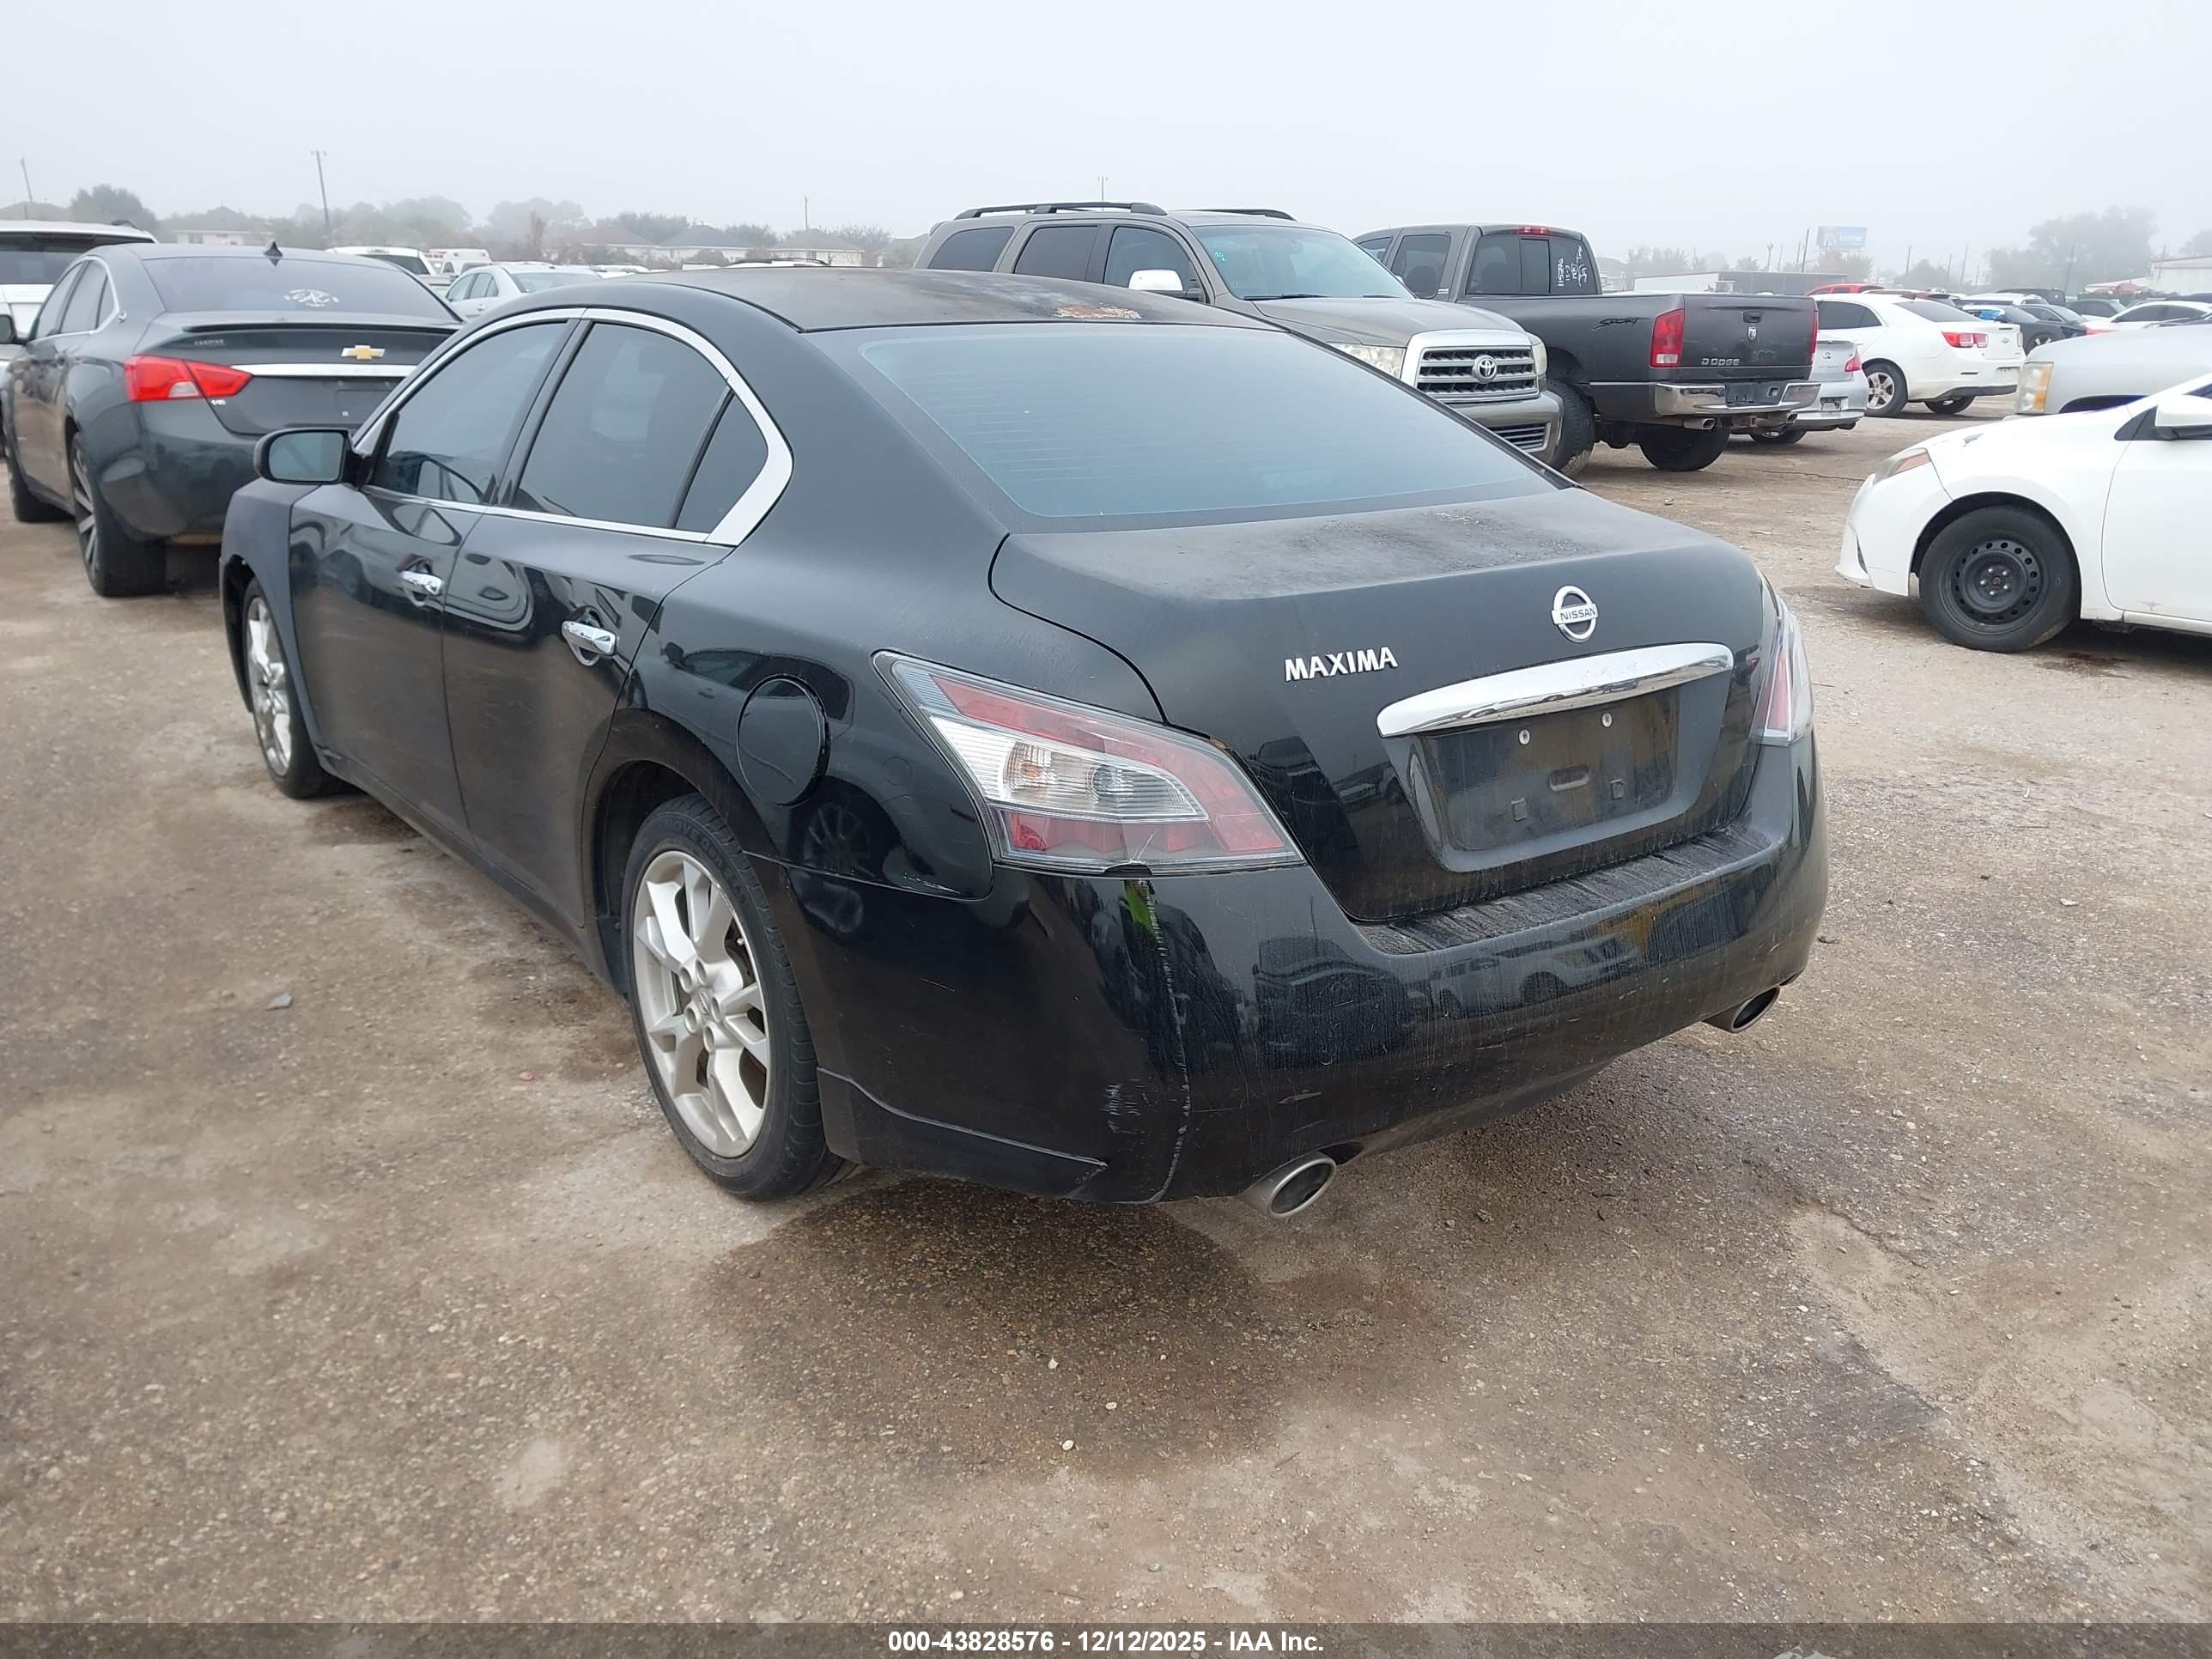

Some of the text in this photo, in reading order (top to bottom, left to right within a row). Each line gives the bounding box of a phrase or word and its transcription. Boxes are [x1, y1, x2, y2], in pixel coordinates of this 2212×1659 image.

[1701, 357, 1741, 366] DODGE
[1559, 607, 1595, 621] NISSAN
[1285, 647, 1399, 682] MAXIMA
